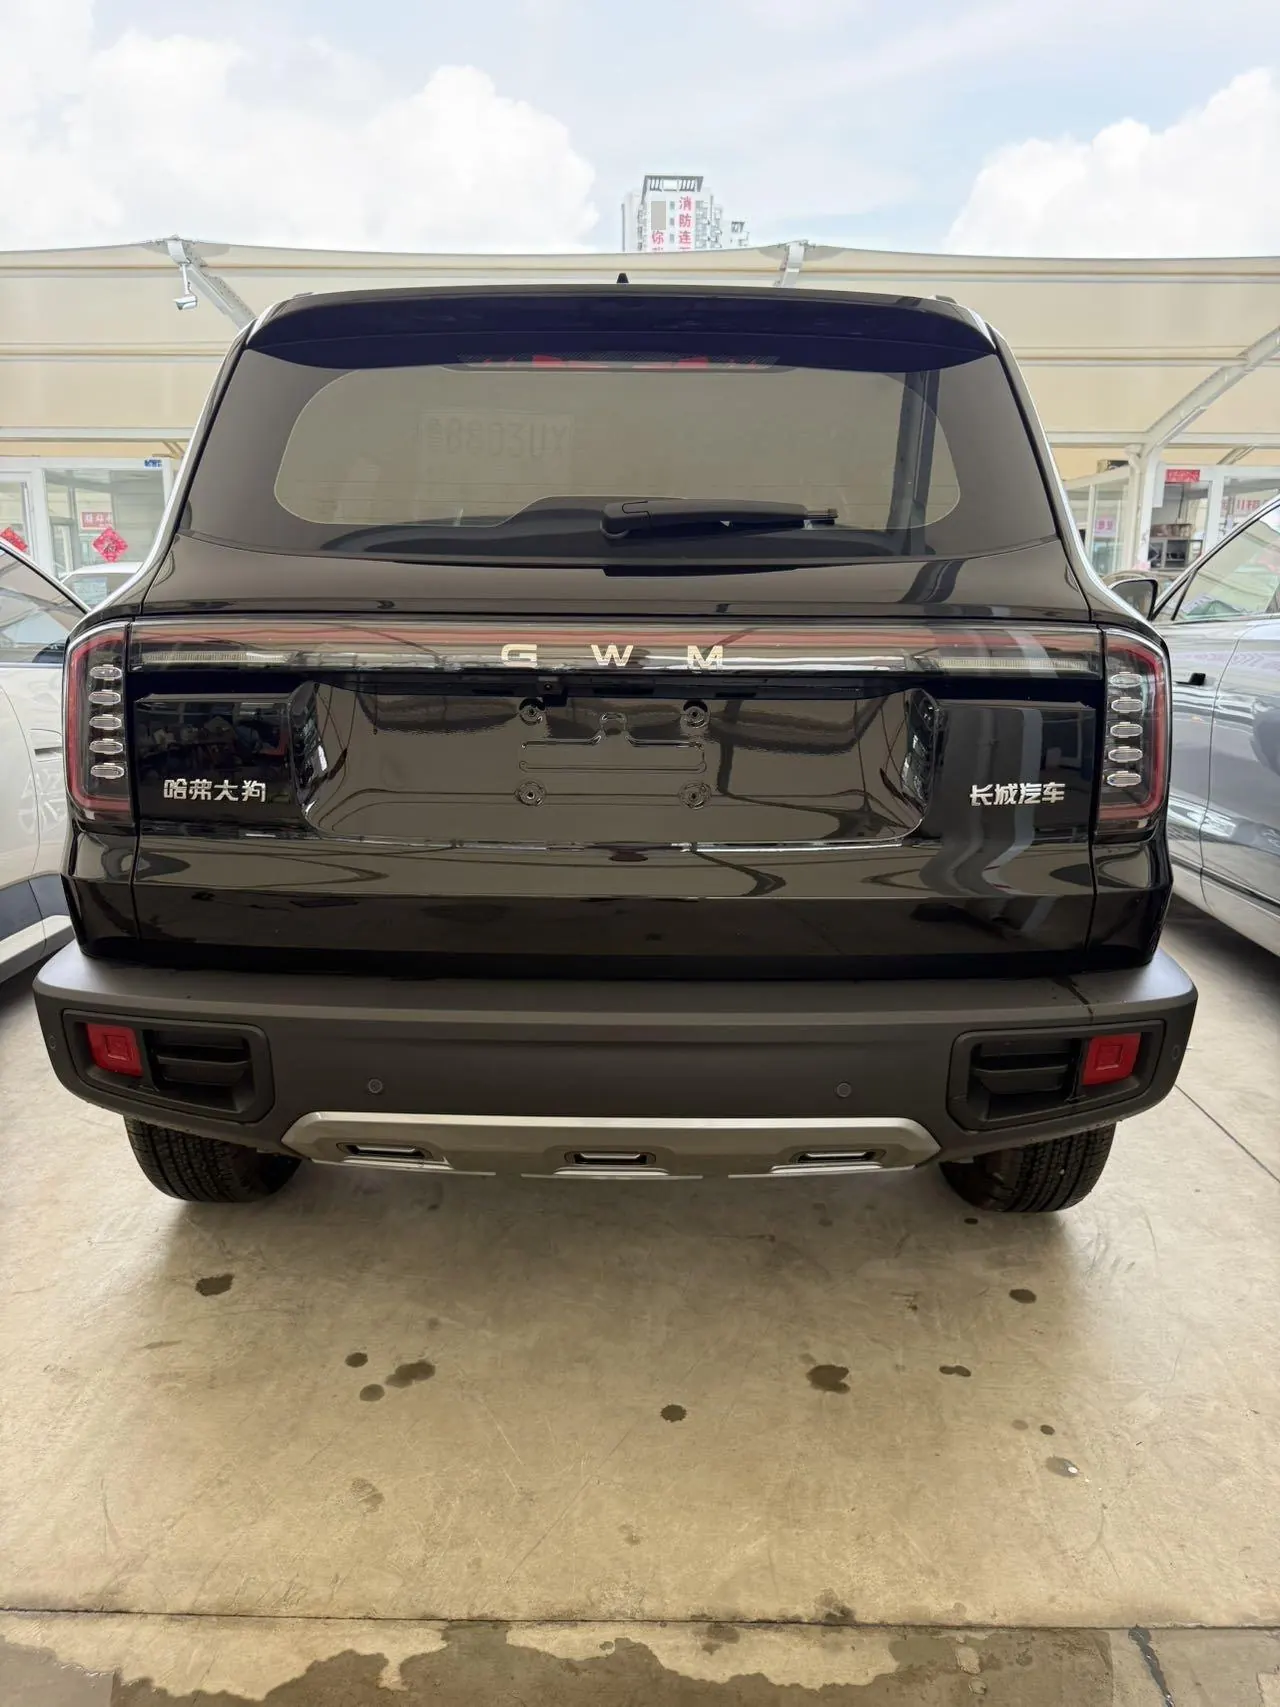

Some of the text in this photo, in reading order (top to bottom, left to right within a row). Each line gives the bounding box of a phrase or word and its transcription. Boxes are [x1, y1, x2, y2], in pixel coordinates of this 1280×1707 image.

[679, 196, 692, 249] 消防连
[163, 778, 266, 802] 哈弗大狗
[969, 781, 1066, 806] 长城汽车
